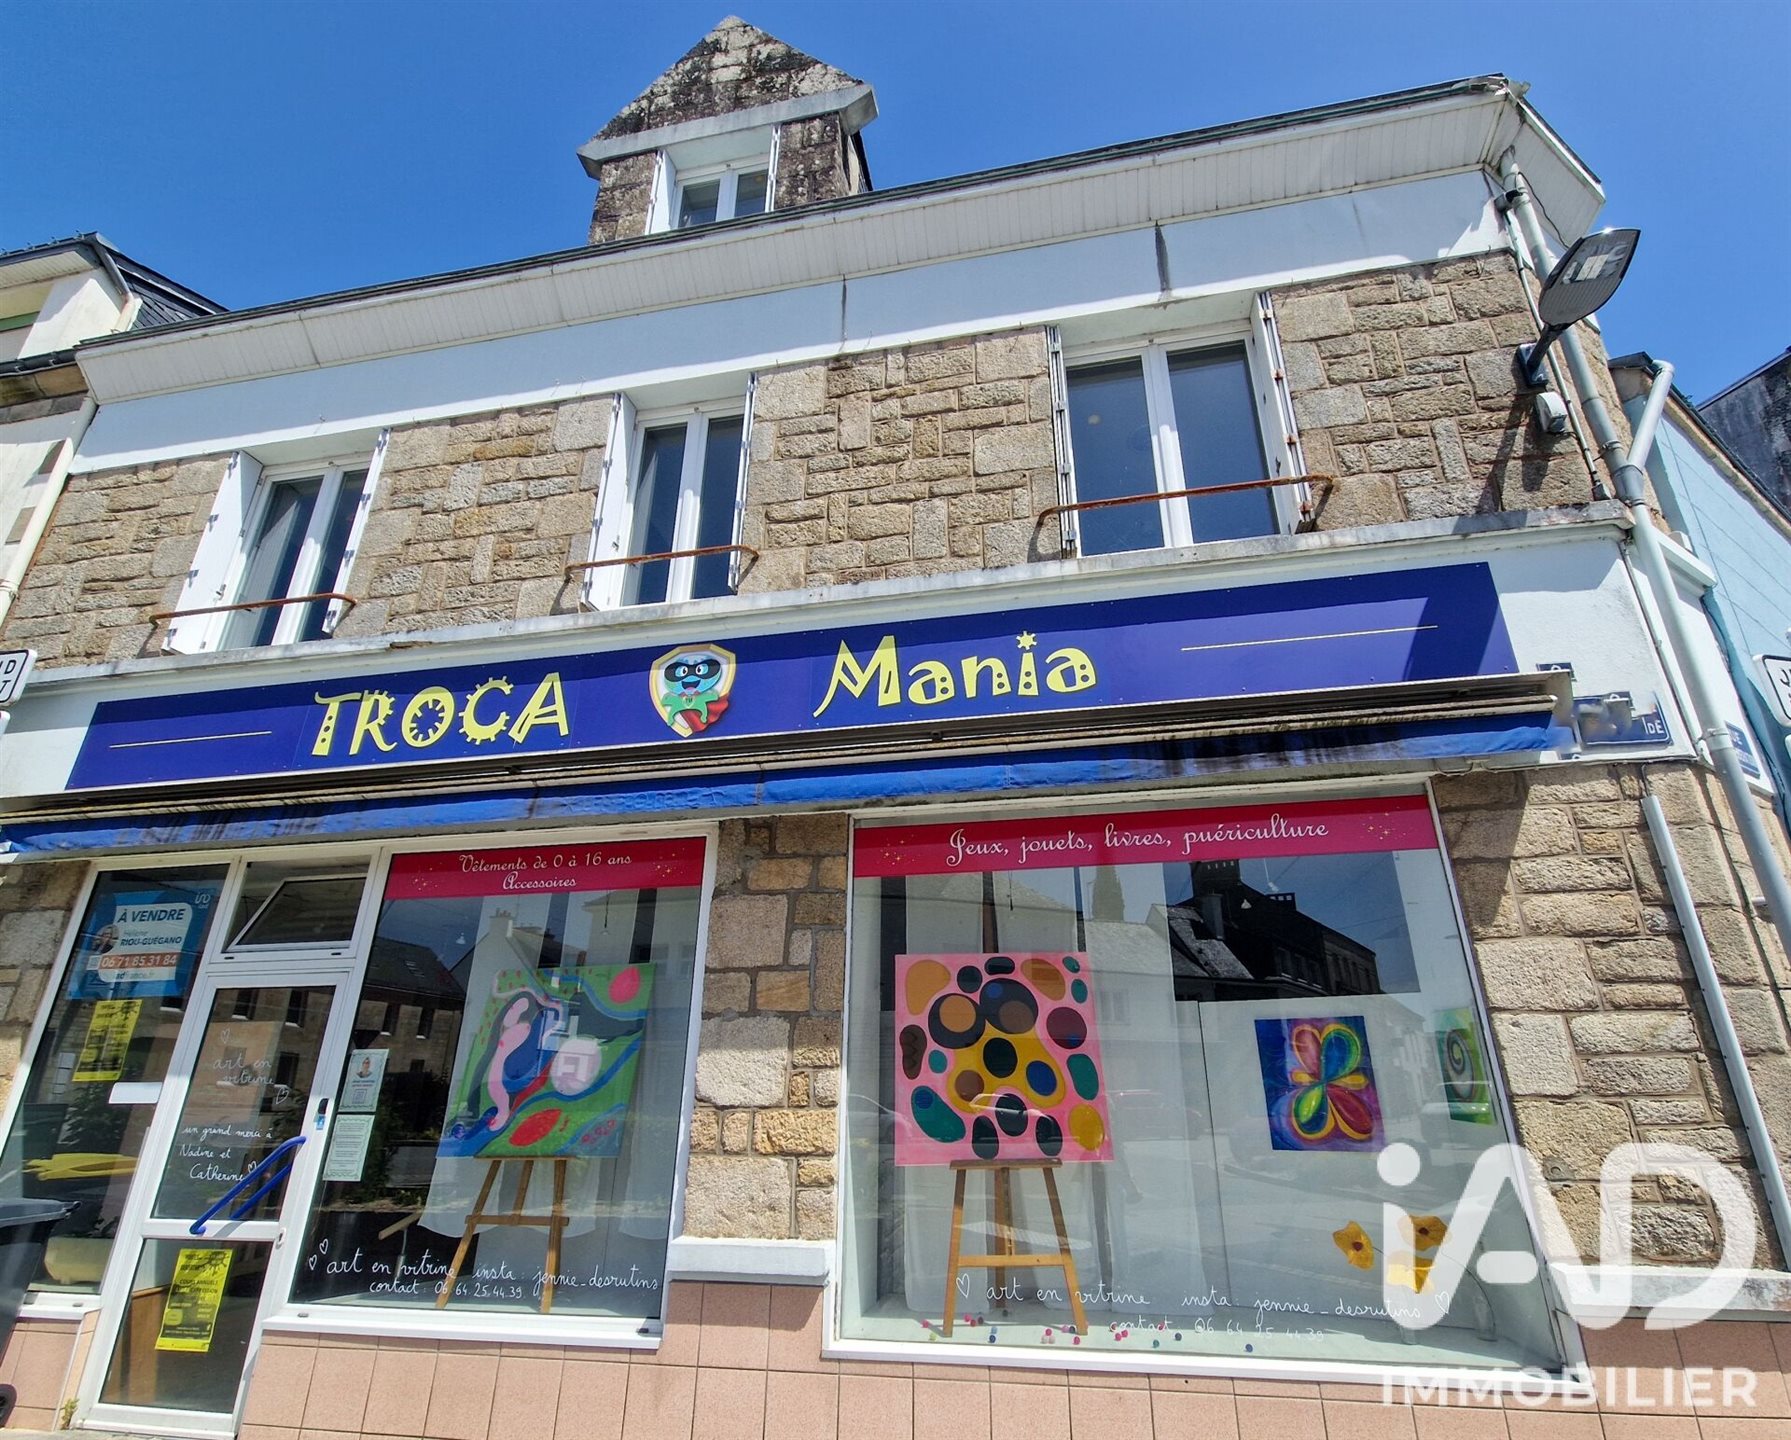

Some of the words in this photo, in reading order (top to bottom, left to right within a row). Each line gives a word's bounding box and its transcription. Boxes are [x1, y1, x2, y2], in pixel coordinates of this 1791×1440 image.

[314, 672, 569, 756] TROCA
[813, 630, 1096, 718] Mania
[946, 828, 1008, 867] Jeux,
[1018, 830, 1093, 864] jouets,
[1104, 822, 1171, 848] livres,
[1182, 813, 1328, 855] puériculture
[459, 854, 527, 873] Vêtements
[533, 854, 548, 869] de
[553, 854, 564, 868] 0
[568, 854, 578, 867] à
[585, 852, 602, 866] 16
[608, 856, 632, 866] ans
[503, 871, 577, 890] Accessoires
[118, 908, 127, 923] À
[131, 908, 186, 922] VENDRE
[102, 957, 114, 968] 06
[117, 957, 130, 967] 71
[163, 954, 177, 965] 84
[213, 1052, 244, 1069] art
[253, 1060, 272, 1068] en
[182, 1126, 199, 1135] un
[200, 1124, 232, 1141] grand
[235, 1128, 261, 1138] merci
[179, 1144, 214, 1159] Nadine
[219, 1147, 231, 1159] et
[189, 1163, 245, 1182] Catherine
[326, 1247, 363, 1274] art
[371, 1261, 392, 1275] en
[400, 1249, 457, 1279] vitrine
[986, 1277, 1024, 1301] art
[1036, 1288, 1063, 1302] en
[1075, 1280, 1151, 1305] vitrine
